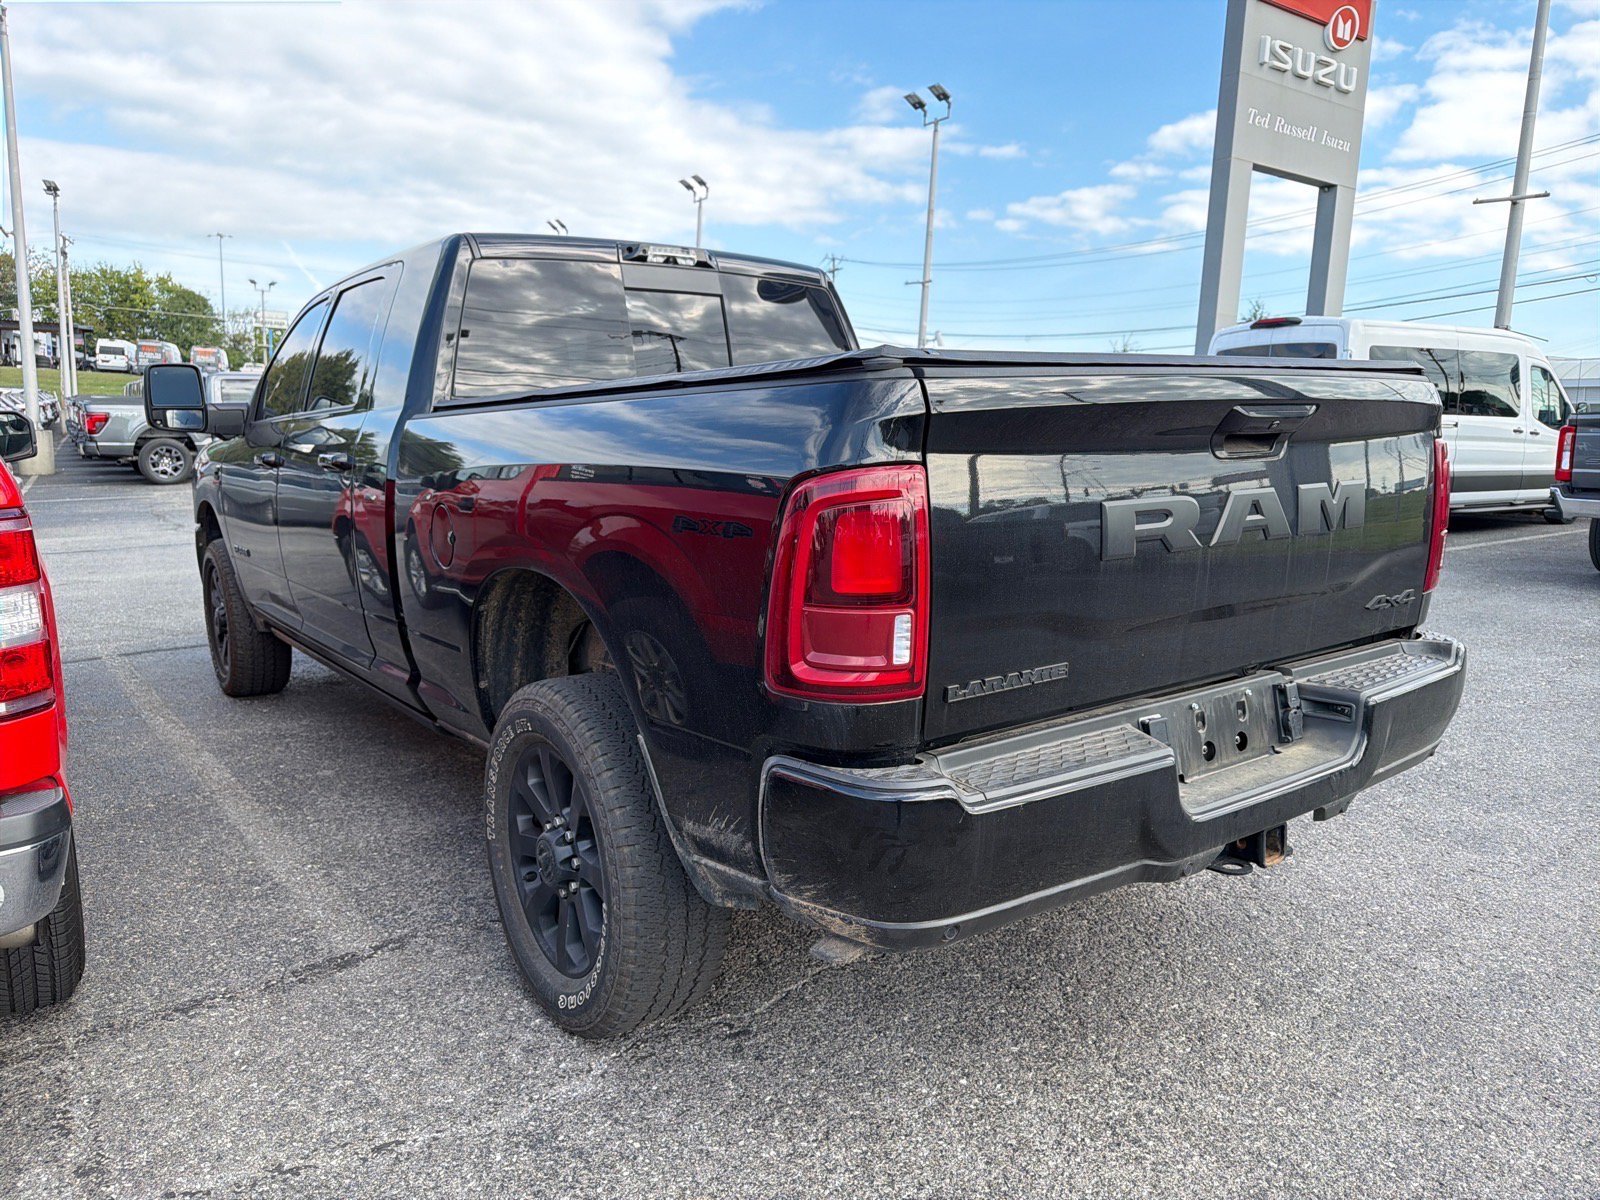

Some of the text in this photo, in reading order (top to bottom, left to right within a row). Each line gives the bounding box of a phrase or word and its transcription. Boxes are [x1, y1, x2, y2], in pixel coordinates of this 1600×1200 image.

[1258, 35, 1358, 94] ISUZU
[1247, 107, 1351, 152] Ted Russell Isuzu
[1100, 479, 1366, 561] RAM
[942, 661, 1069, 703] LARAMIE
